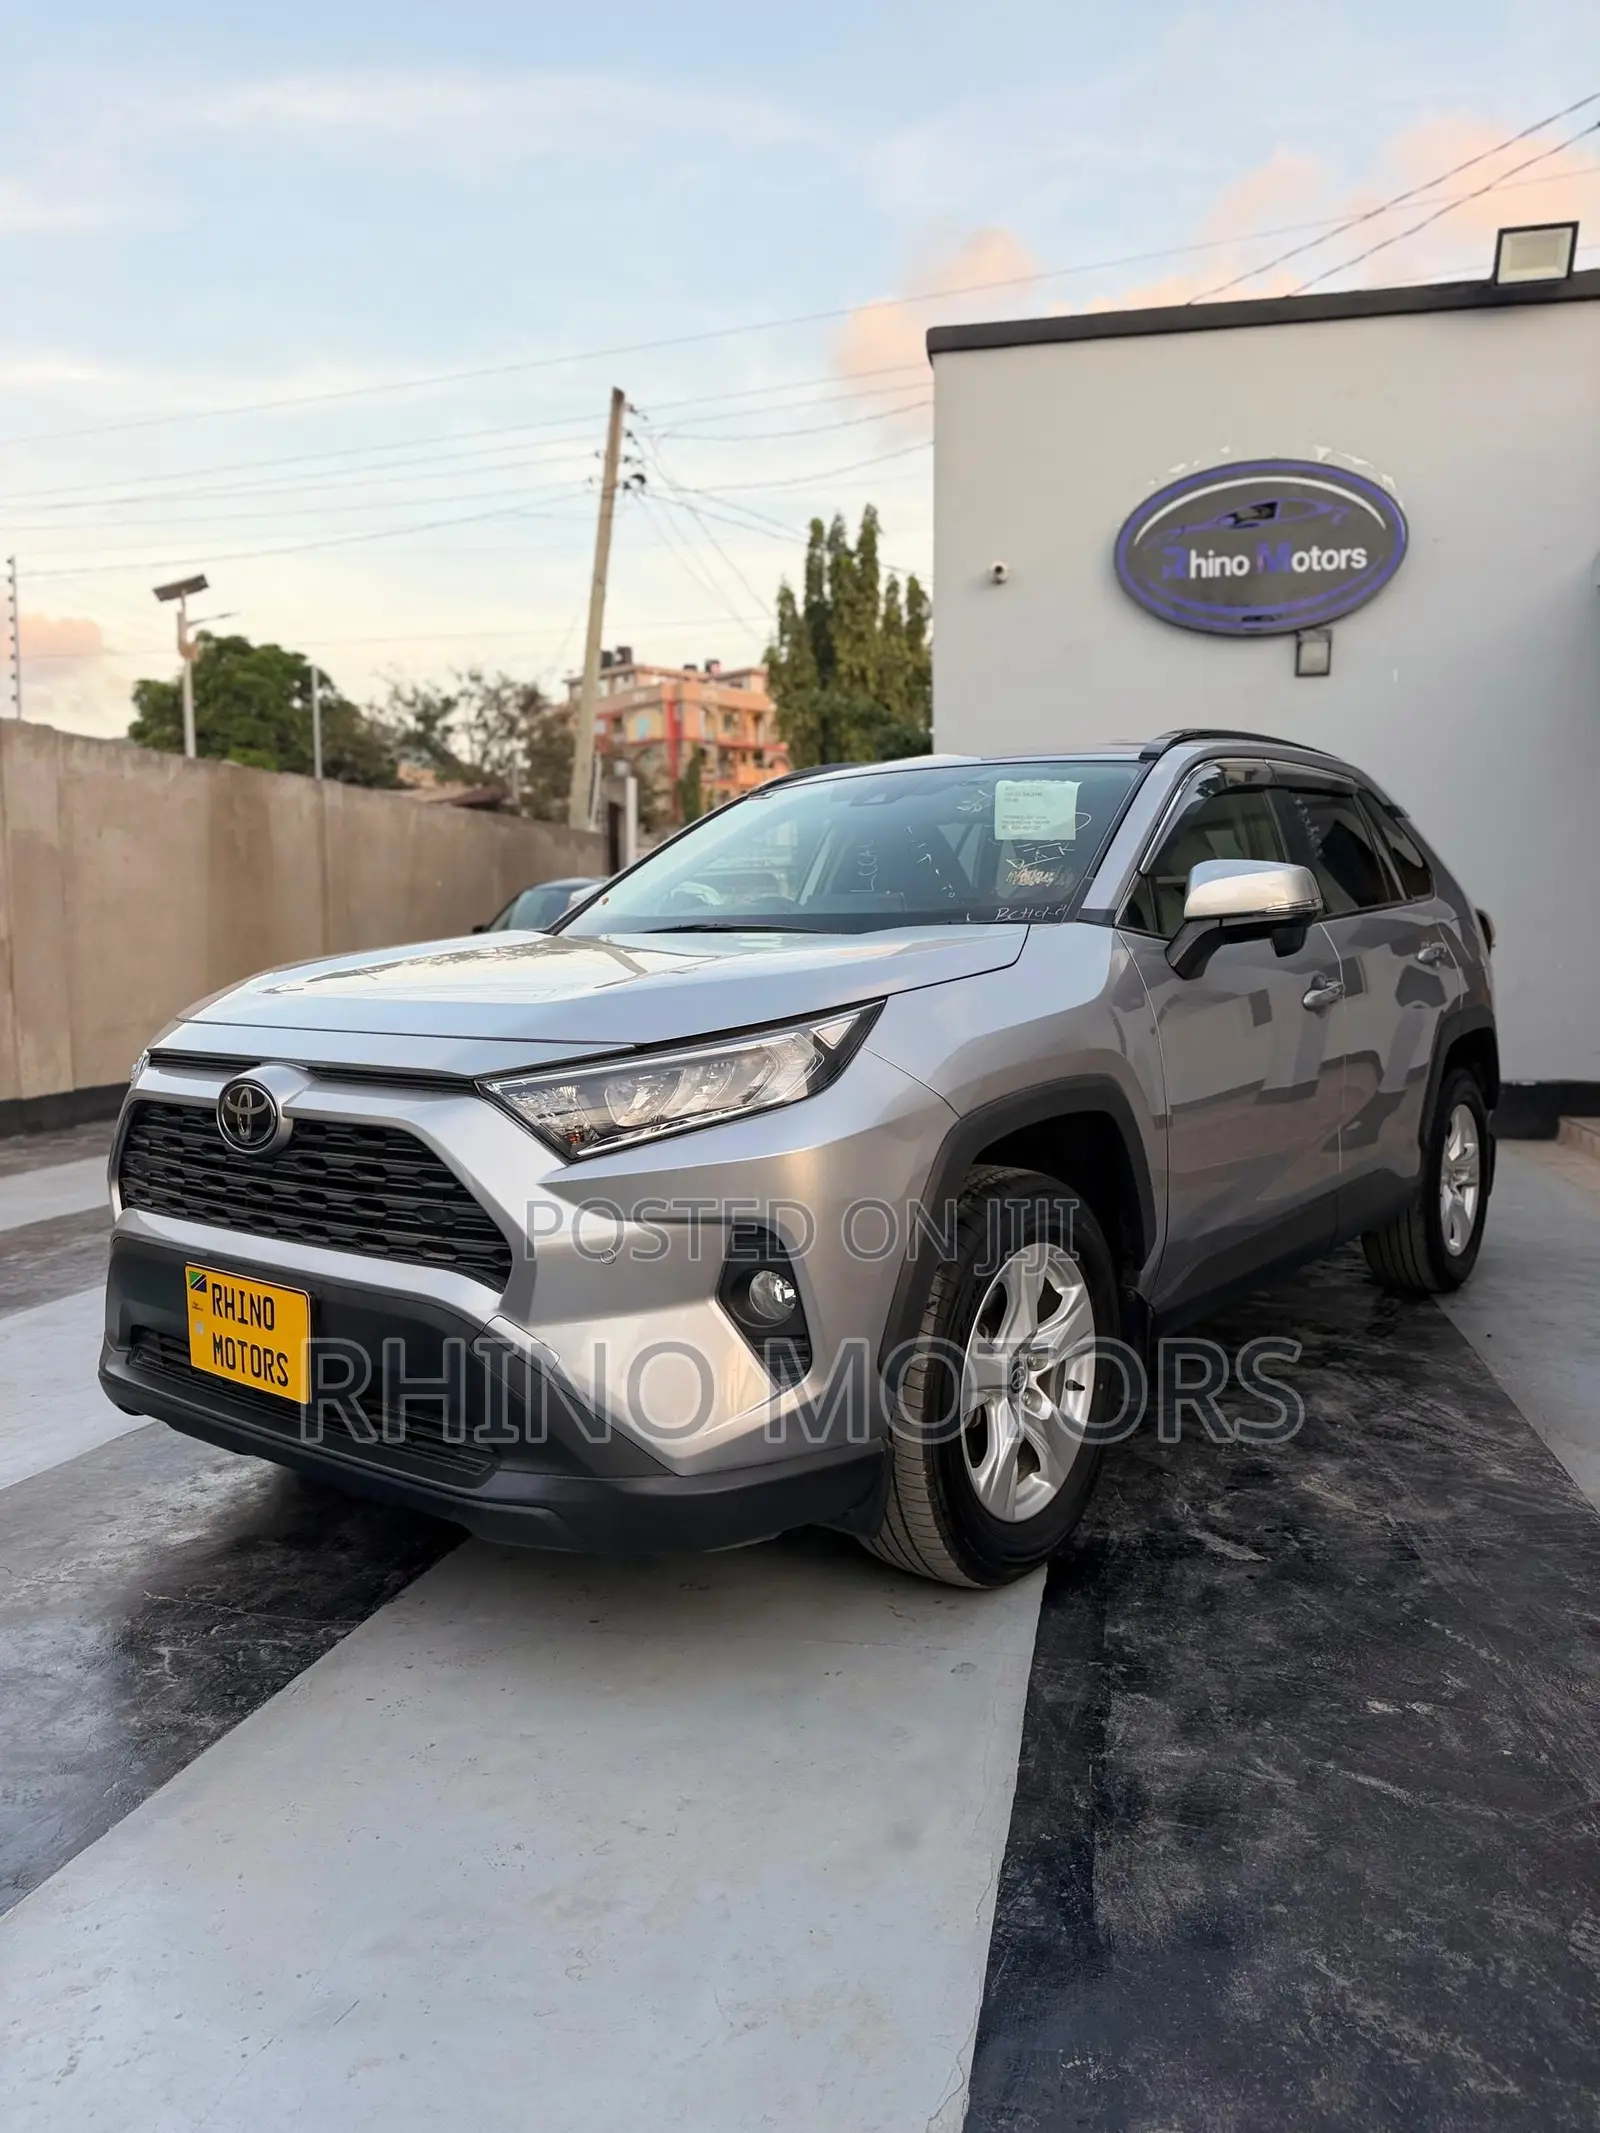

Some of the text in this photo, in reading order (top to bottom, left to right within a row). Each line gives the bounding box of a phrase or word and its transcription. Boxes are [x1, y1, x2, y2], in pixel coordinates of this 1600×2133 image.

[1161, 540, 1368, 580] Rhino Motors
[212, 1283, 275, 1331] RHINO
[212, 1332, 289, 1387] MOTORS
